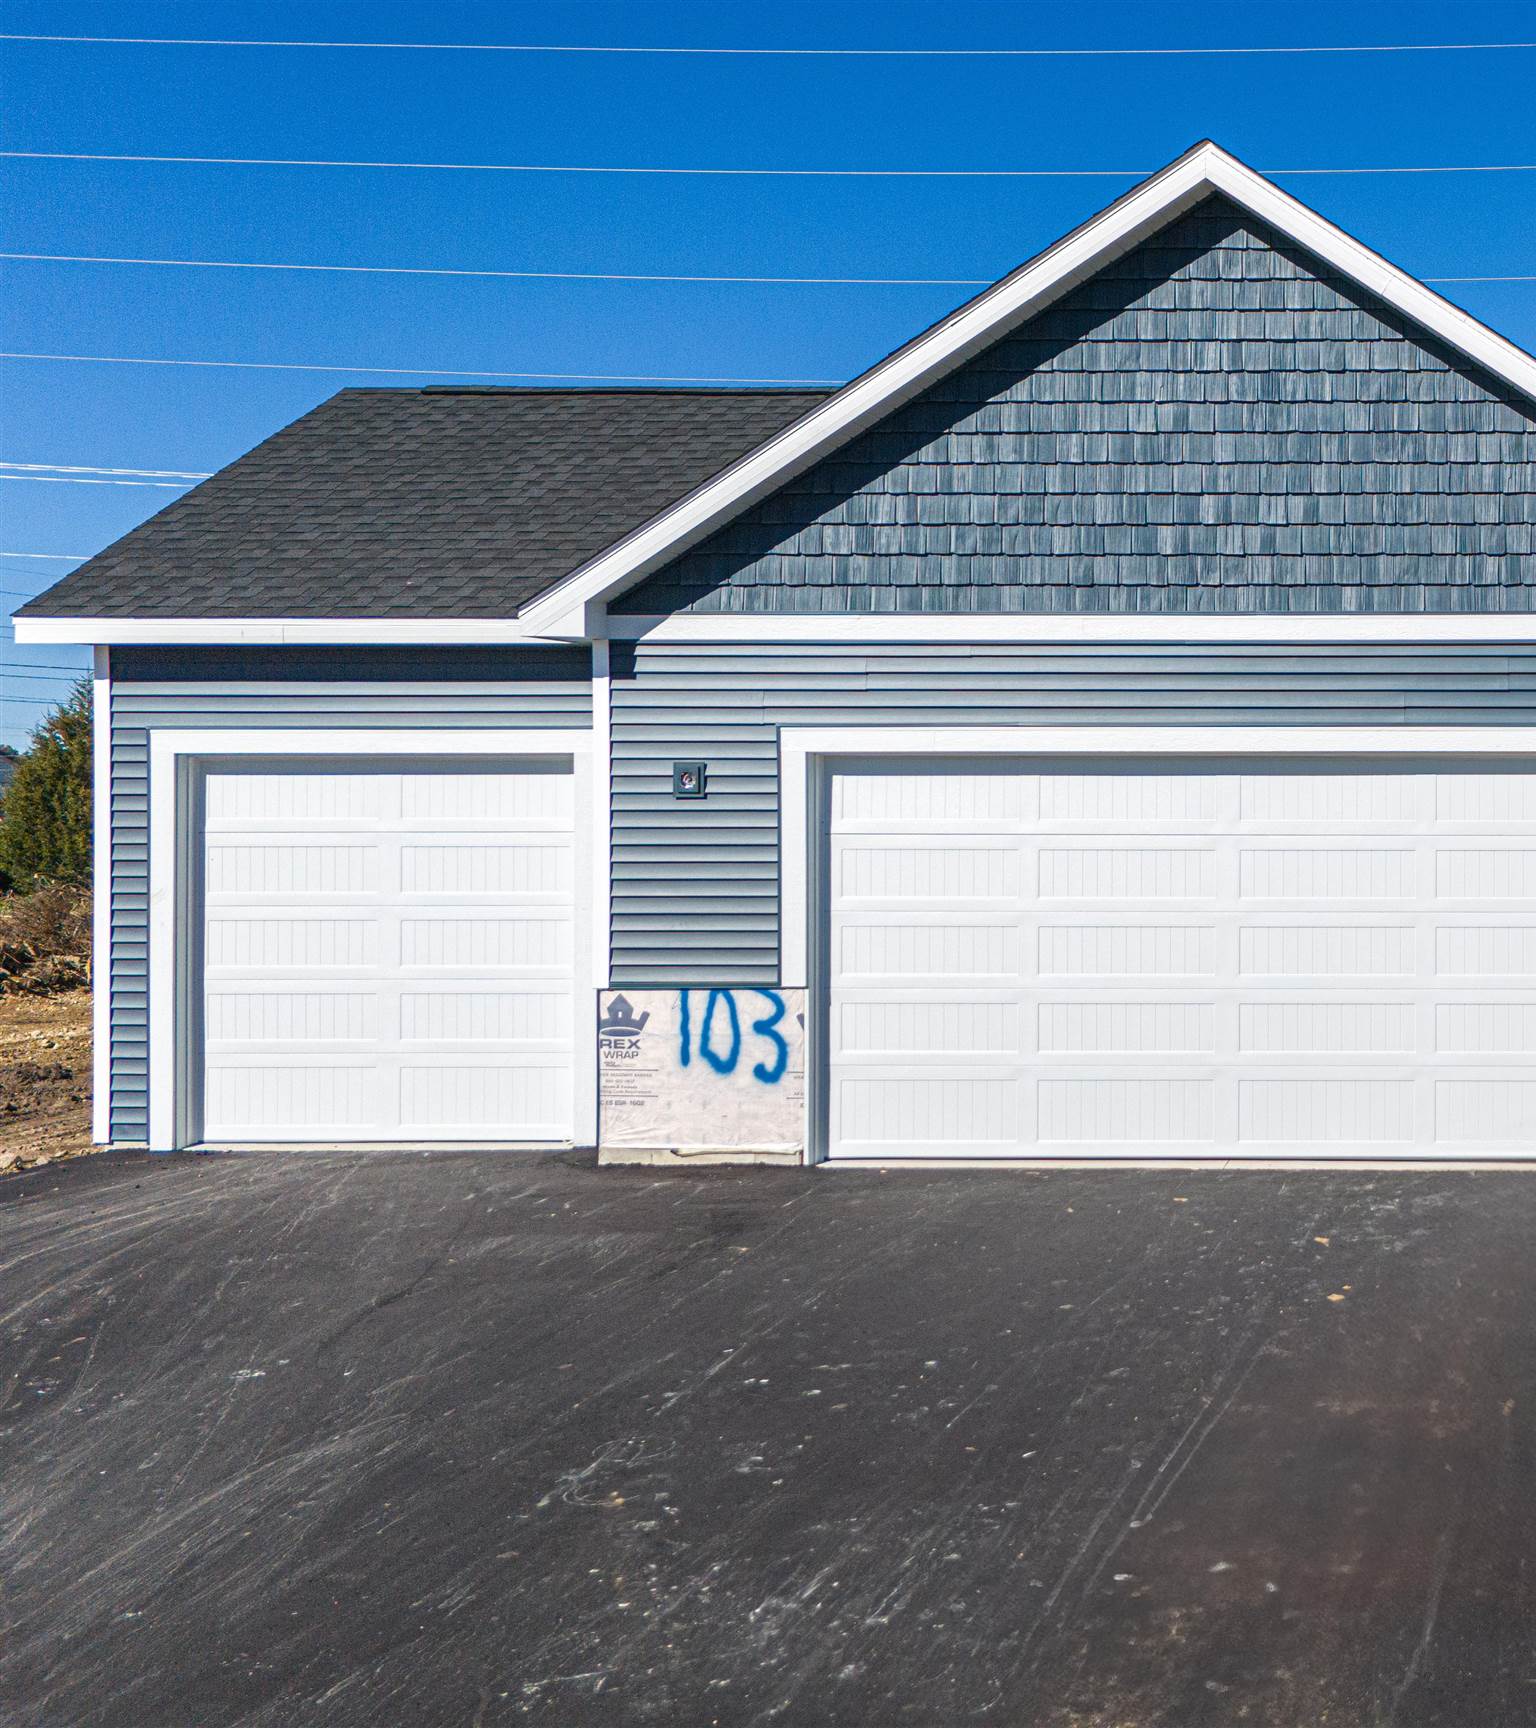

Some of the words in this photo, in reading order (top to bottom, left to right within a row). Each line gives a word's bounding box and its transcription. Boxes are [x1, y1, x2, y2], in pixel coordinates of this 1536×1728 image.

[680, 989, 789, 1084] 103
[600, 1038, 641, 1050] REX
[603, 1050, 639, 1059] WRAP
